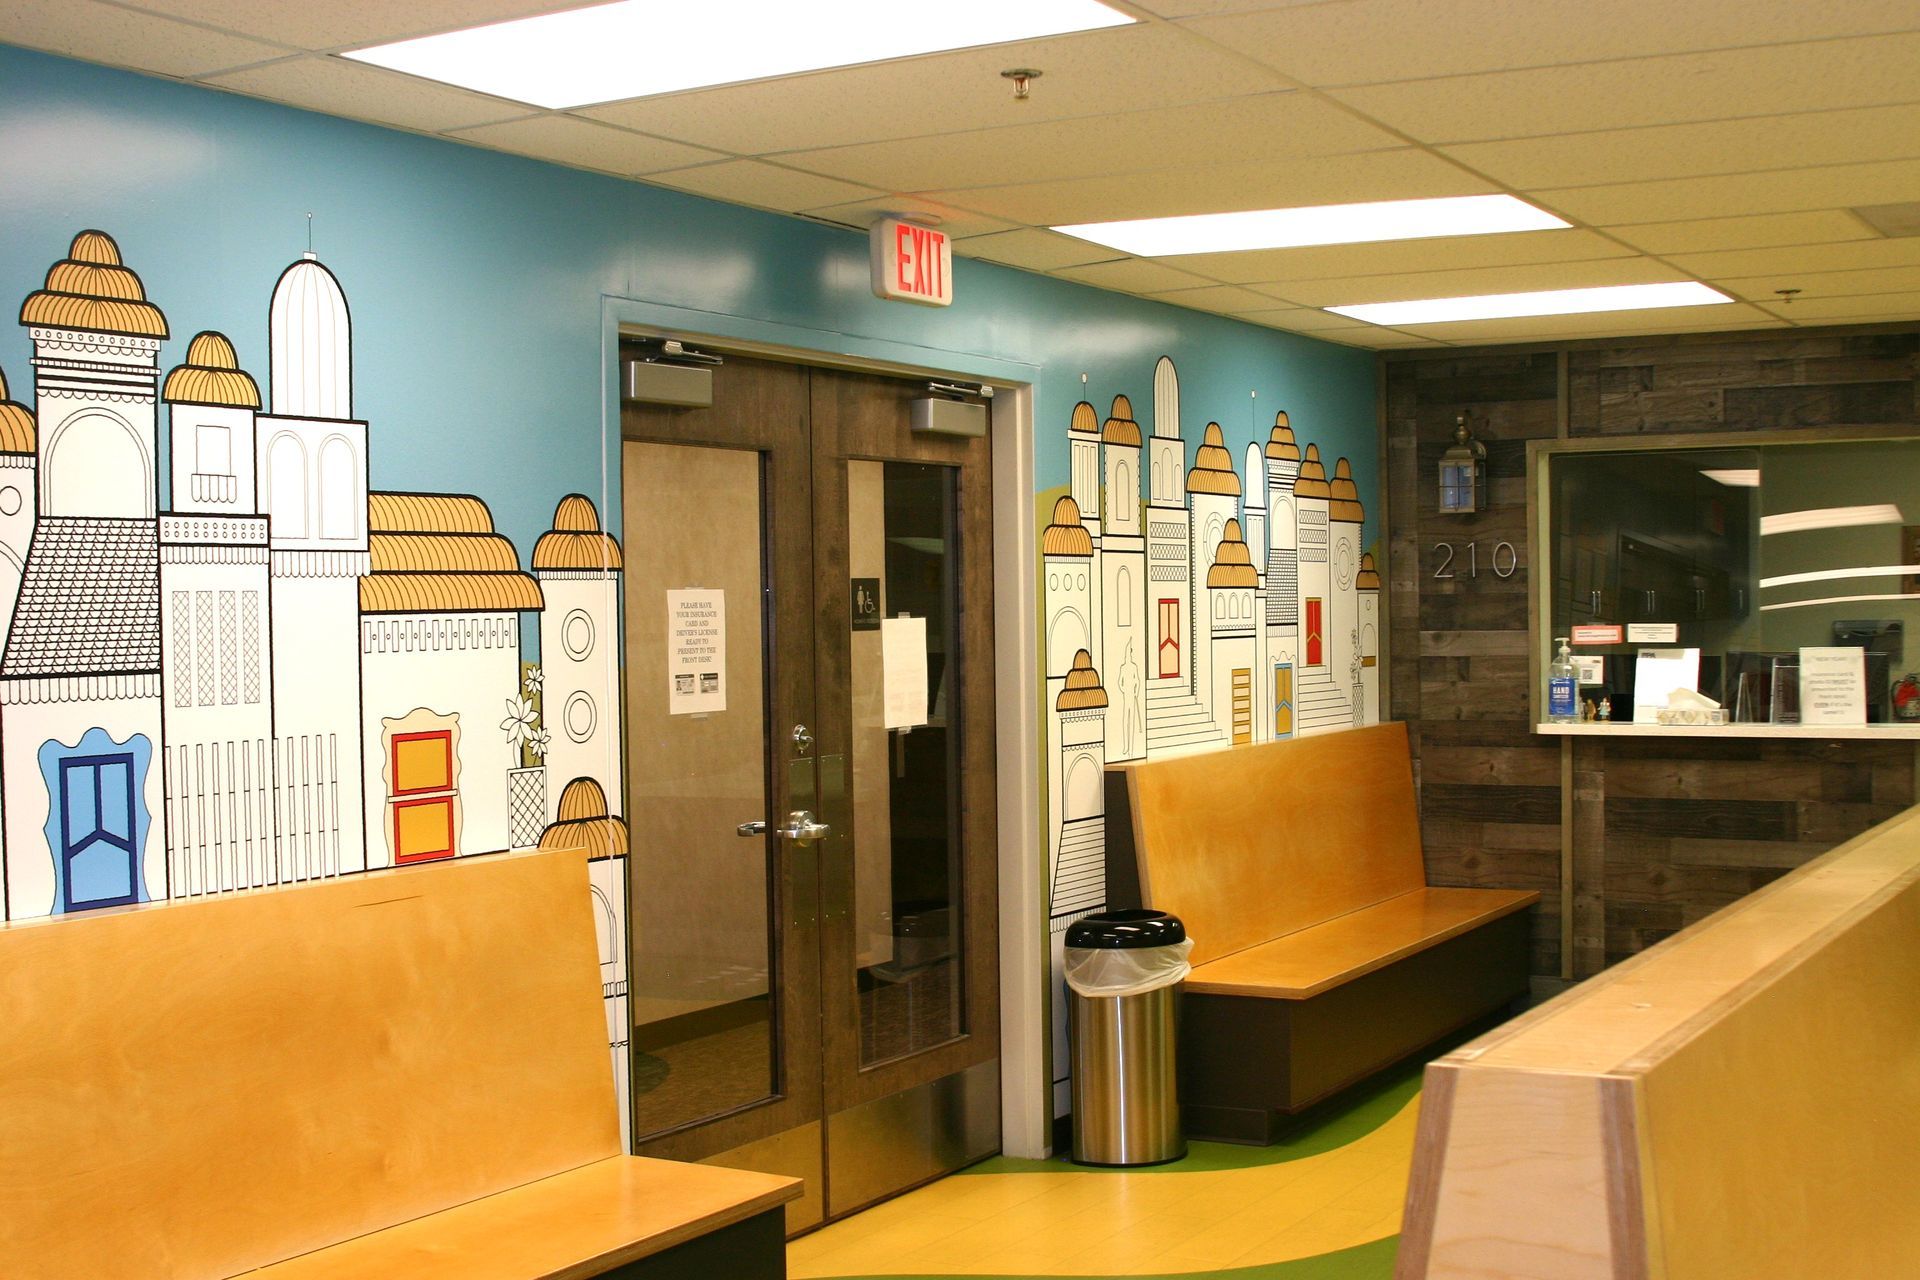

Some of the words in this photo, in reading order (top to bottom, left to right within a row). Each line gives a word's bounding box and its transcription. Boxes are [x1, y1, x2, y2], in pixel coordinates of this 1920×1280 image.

[896, 224, 944, 298] EXIT
[1433, 541, 1516, 578] 210
[678, 647, 699, 655] PRESENT
